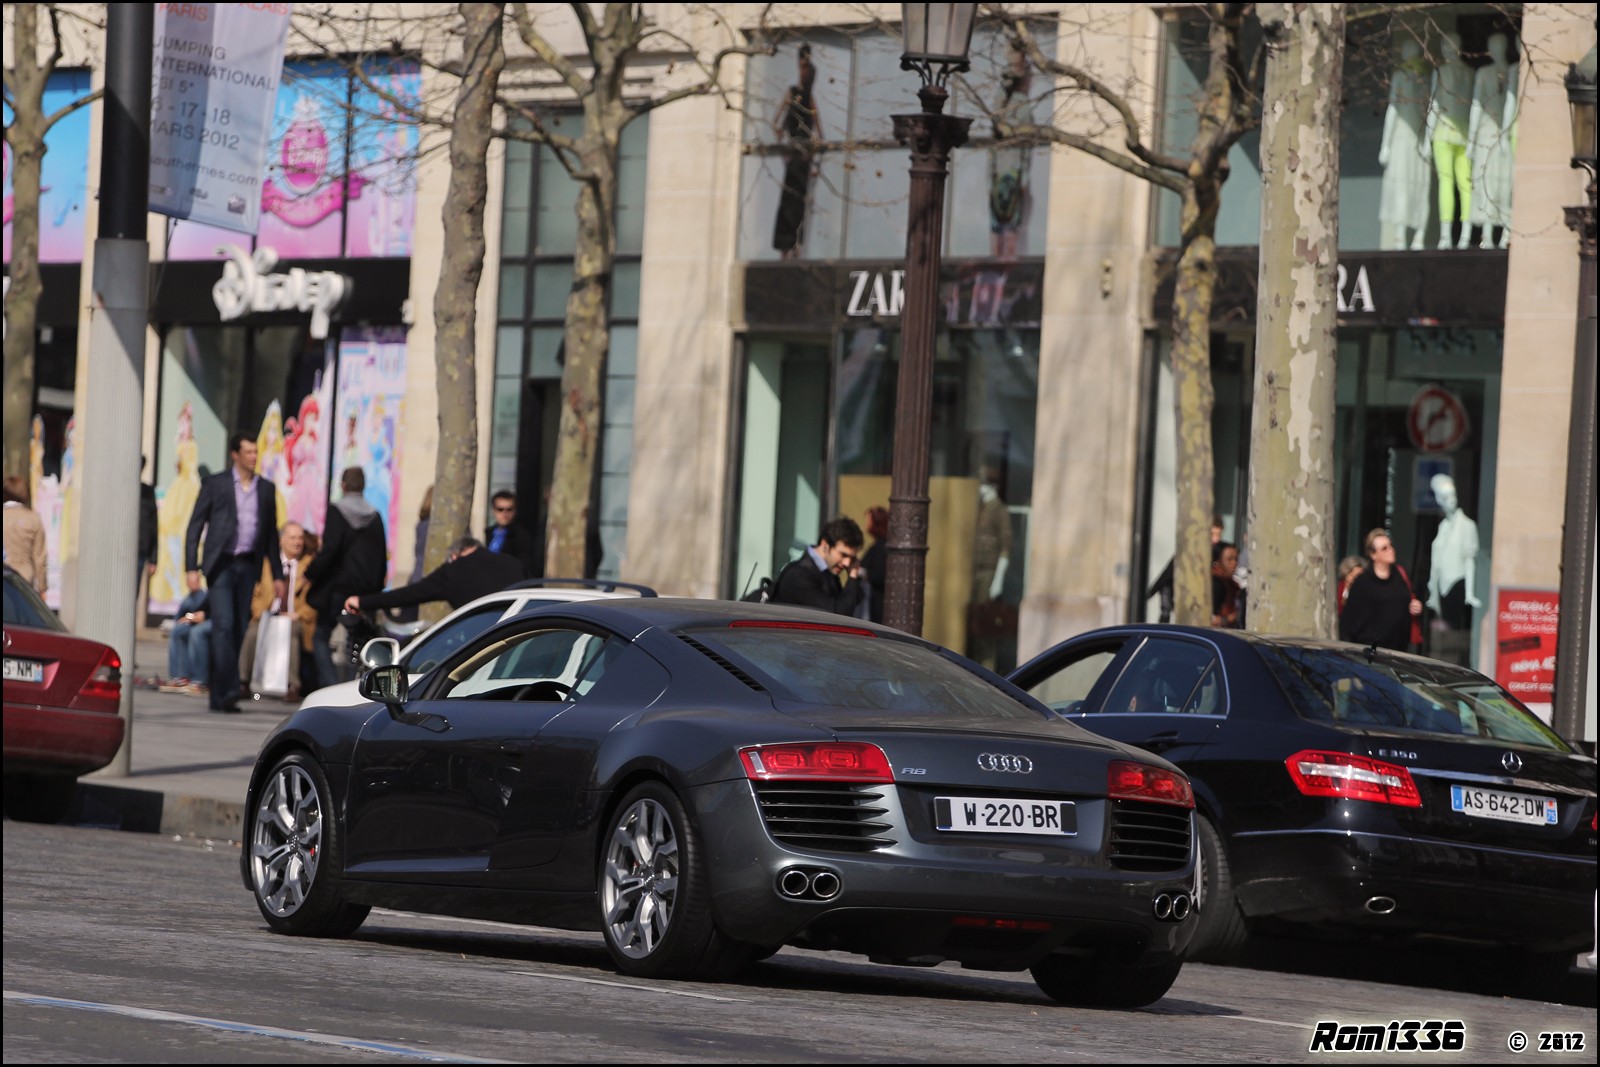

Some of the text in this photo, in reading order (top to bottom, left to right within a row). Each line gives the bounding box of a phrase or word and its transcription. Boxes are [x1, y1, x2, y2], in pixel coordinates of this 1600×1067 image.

[152, 36, 226, 60] JUMPING
[153, 55, 275, 90] NTERNATIONAL
[180, 101, 200, 119] 17
[212, 107, 231, 126] 18
[199, 127, 240, 151] 2012
[1547, 811, 1556, 821] 75
